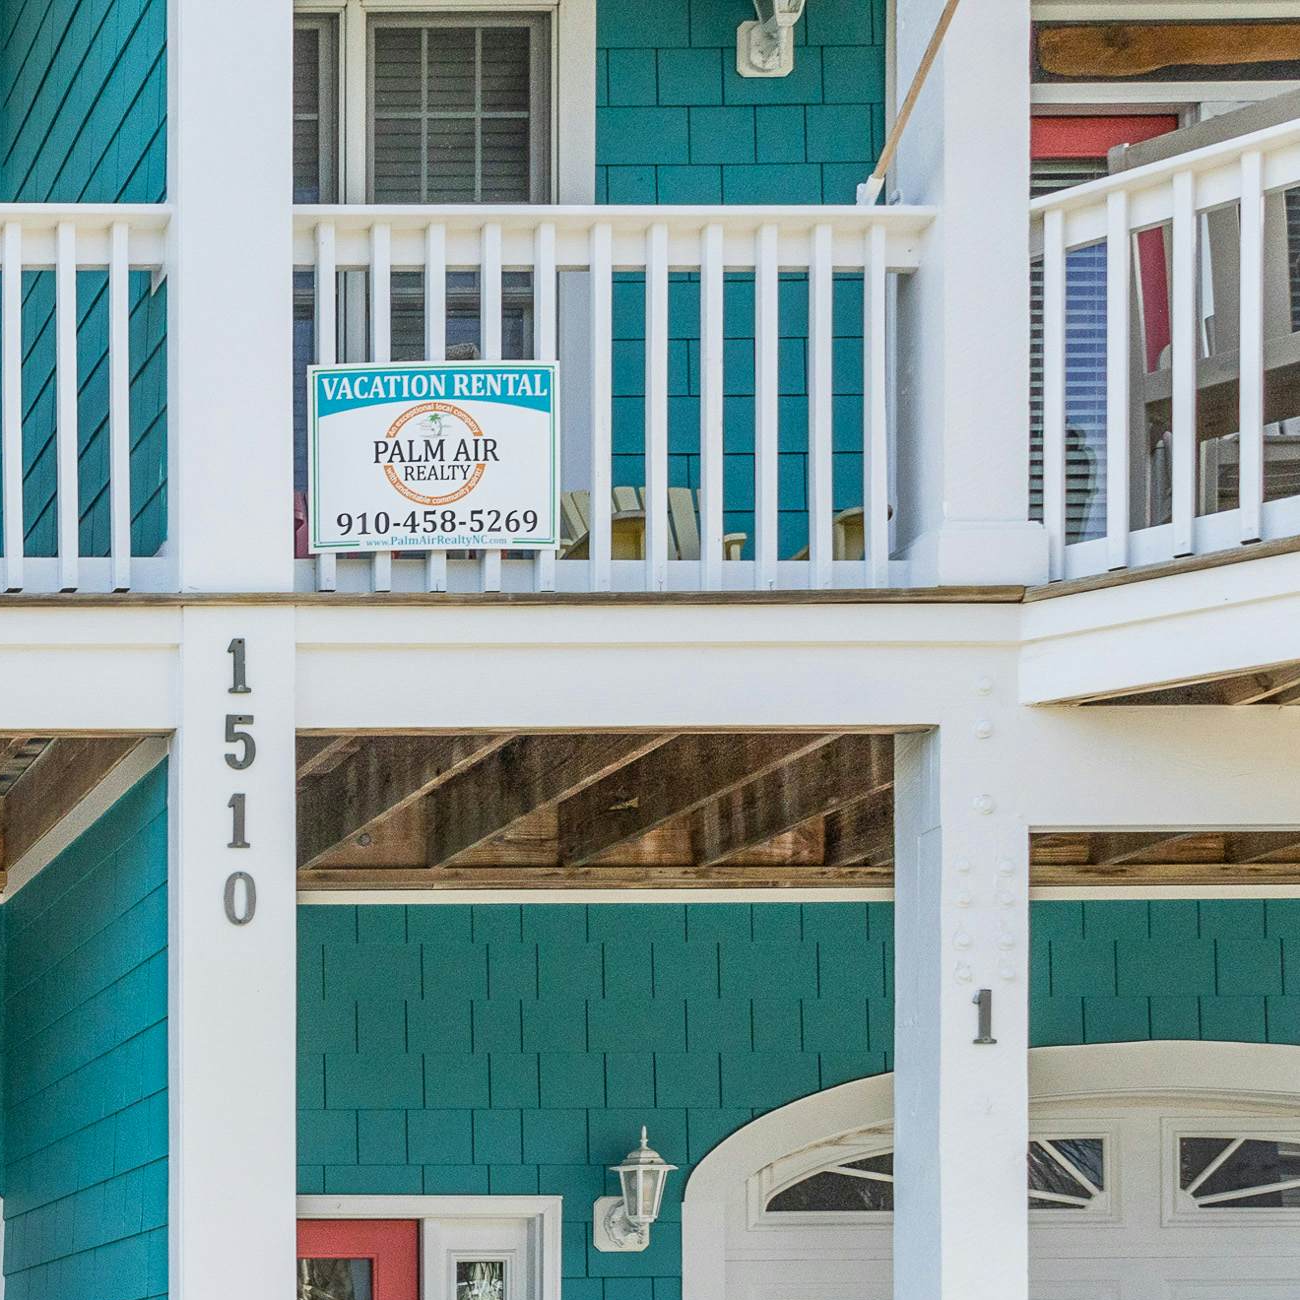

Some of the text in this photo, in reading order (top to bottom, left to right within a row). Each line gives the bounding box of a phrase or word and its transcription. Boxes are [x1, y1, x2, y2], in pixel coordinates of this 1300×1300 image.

[321, 373, 548, 400] VACATION RENTAL
[436, 402, 453, 413] local
[373, 438, 500, 464] PALM AIR
[404, 465, 471, 481] REALTY
[336, 509, 538, 536] 910-458-5269
[366, 534, 507, 547] www.PalmAirRealtyNC.com
[224, 638, 257, 926] 1510
[972, 989, 997, 1044] 1
